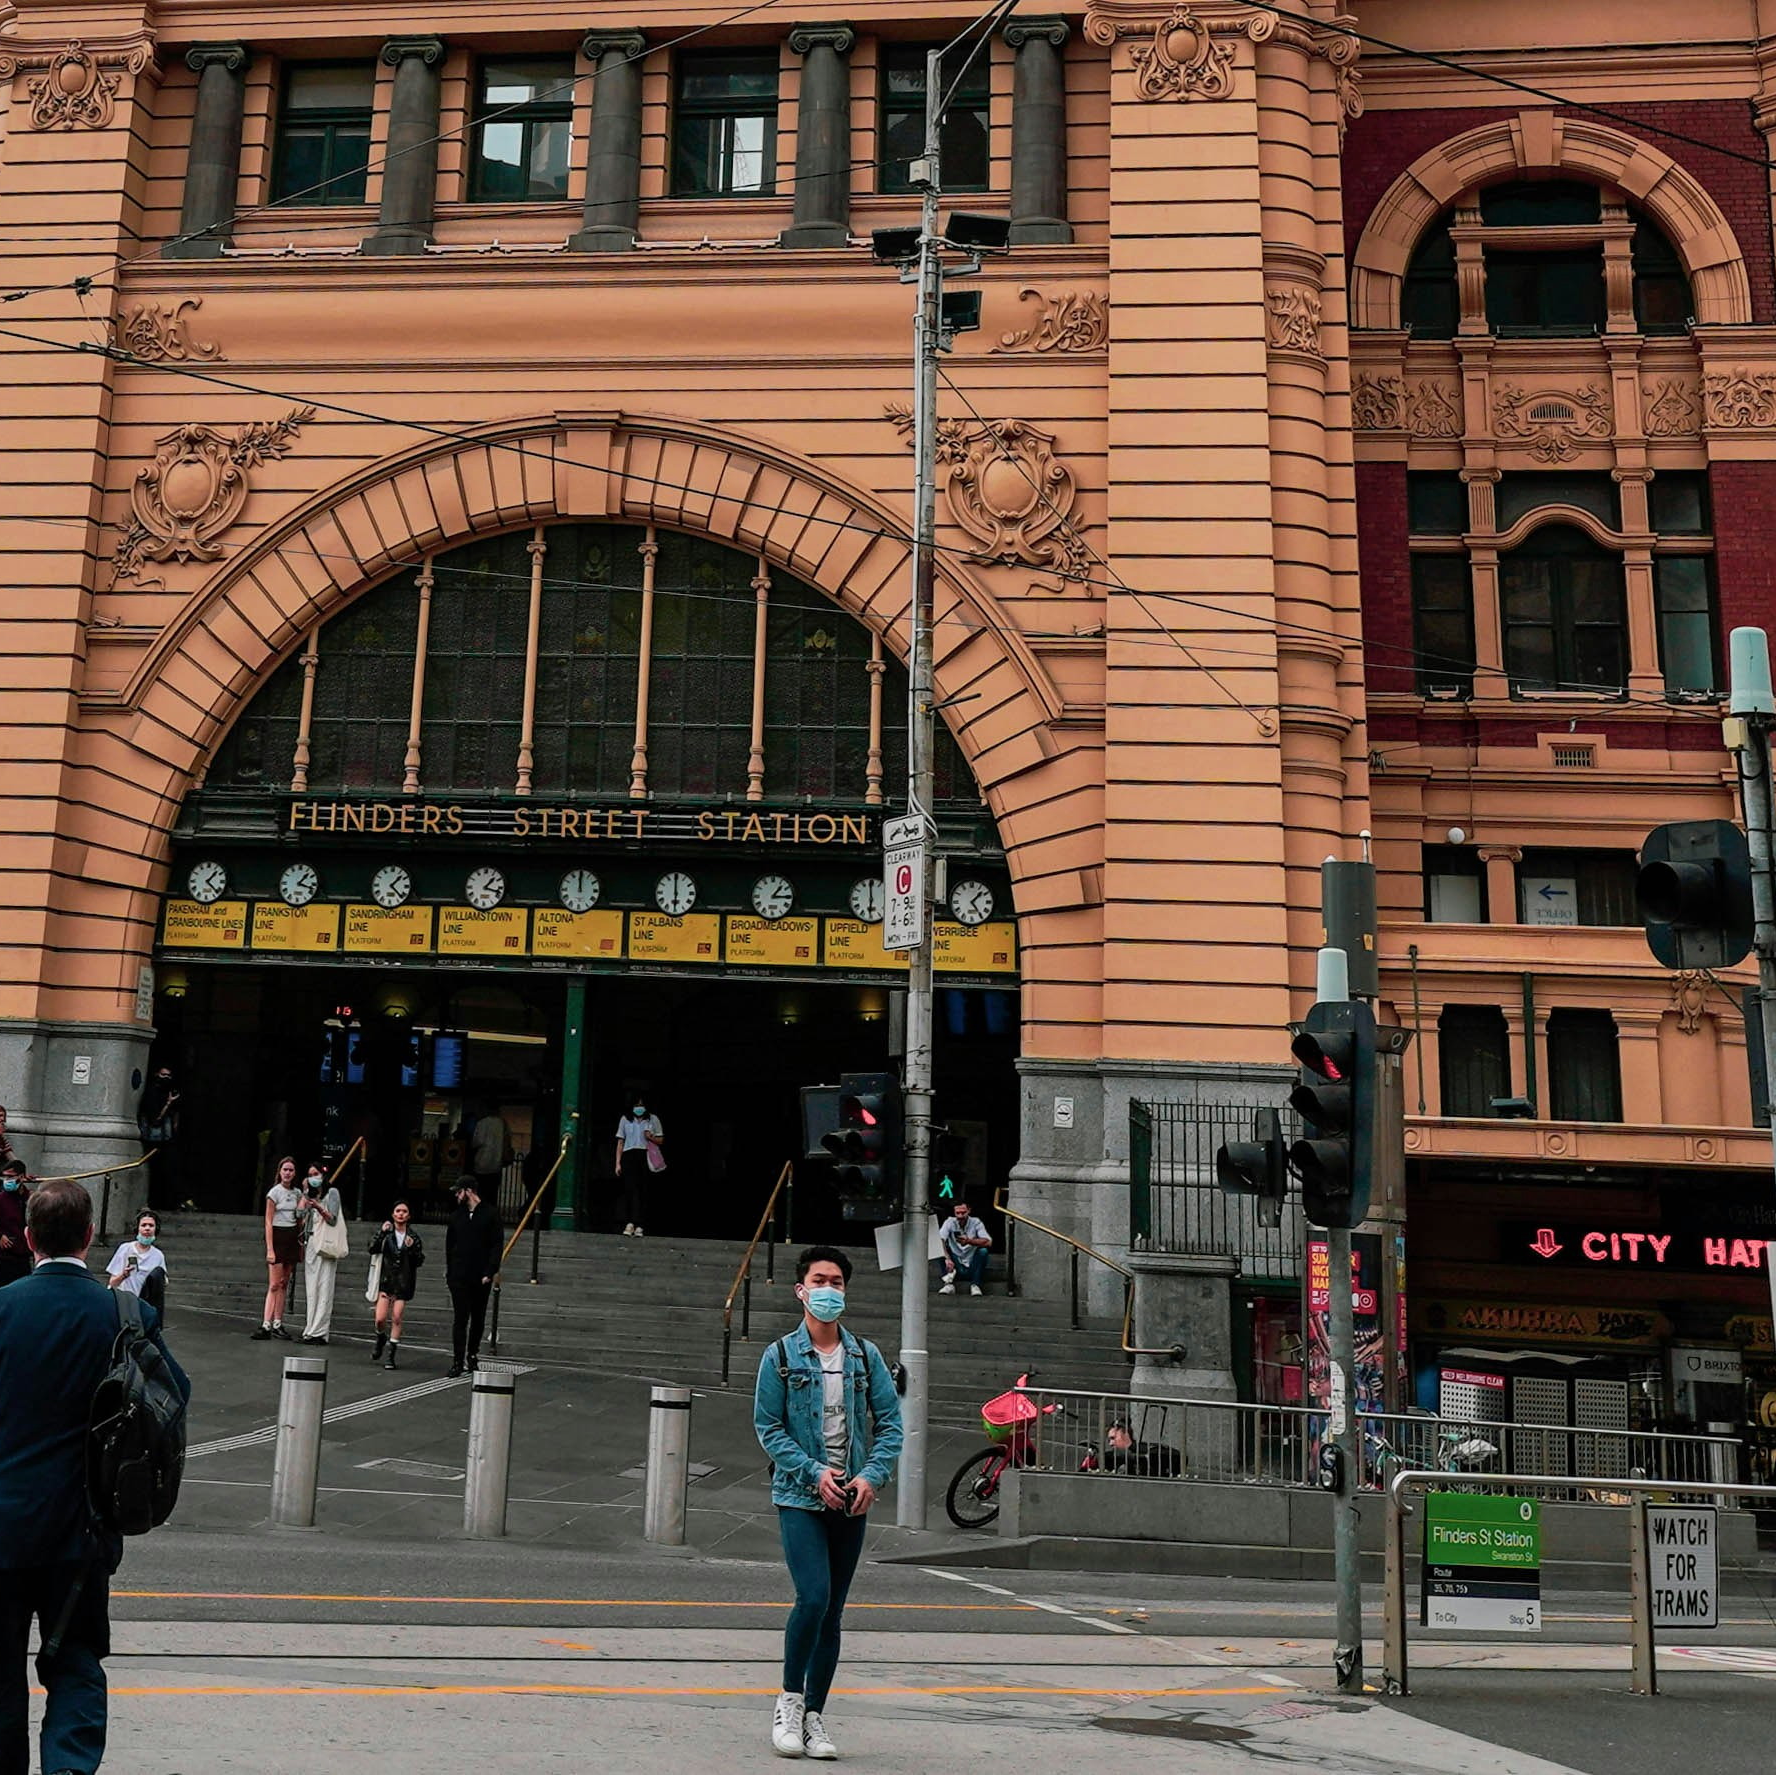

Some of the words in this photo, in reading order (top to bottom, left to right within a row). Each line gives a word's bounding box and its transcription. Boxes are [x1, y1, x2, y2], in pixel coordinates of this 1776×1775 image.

[290, 802, 464, 836] FLINDERS
[513, 807, 650, 839] STREET
[697, 811, 867, 844] STATION
[887, 850, 921, 864] CLEARWAY
[168, 903, 209, 915] PAKENHAM
[255, 906, 308, 918] FRANKSTON
[350, 908, 414, 920] SANDRINGHAM
[444, 911, 513, 922] WILLIAMSTOWN
[538, 912, 574, 924] ALTONA
[634, 916, 646, 927] ST
[648, 917, 683, 928] ALBANS
[222, 919, 244, 930] LINES
[255, 919, 274, 930] LINE
[349, 922, 368, 932] LINE
[443, 924, 463, 934] LINE
[731, 920, 811, 932] BROADMEADOWS
[830, 922, 868, 934] UPFIELD
[537, 926, 558, 936] LINE
[633, 930, 654, 941] LINE
[730, 933, 751, 944] LINE
[829, 936, 850, 947] LINE
[933, 954, 966, 963] LATFORM
[1581, 1231, 1672, 1263] CITY
[1459, 1307, 1587, 1334] AKUBRA
[1456, 1372, 1486, 1385] MELBOURNE
[1486, 1376, 1504, 1387] CLEAN
[1433, 1526, 1478, 1545] Flinders
[1479, 1528, 1493, 1546] St
[1494, 1529, 1534, 1548] Station
[1653, 1517, 1707, 1545] WATCH
[1492, 1550, 1525, 1562] Swanston
[1525, 1552, 1533, 1563] St
[1433, 1567, 1453, 1577] Route
[1666, 1553, 1697, 1581] FOR
[1655, 1589, 1709, 1617] TRAMS
[1435, 1612, 1443, 1622] To
[1444, 1612, 1458, 1624] City
[1509, 1614, 1525, 1626] Stop
[1526, 1607, 1535, 1625] 5
